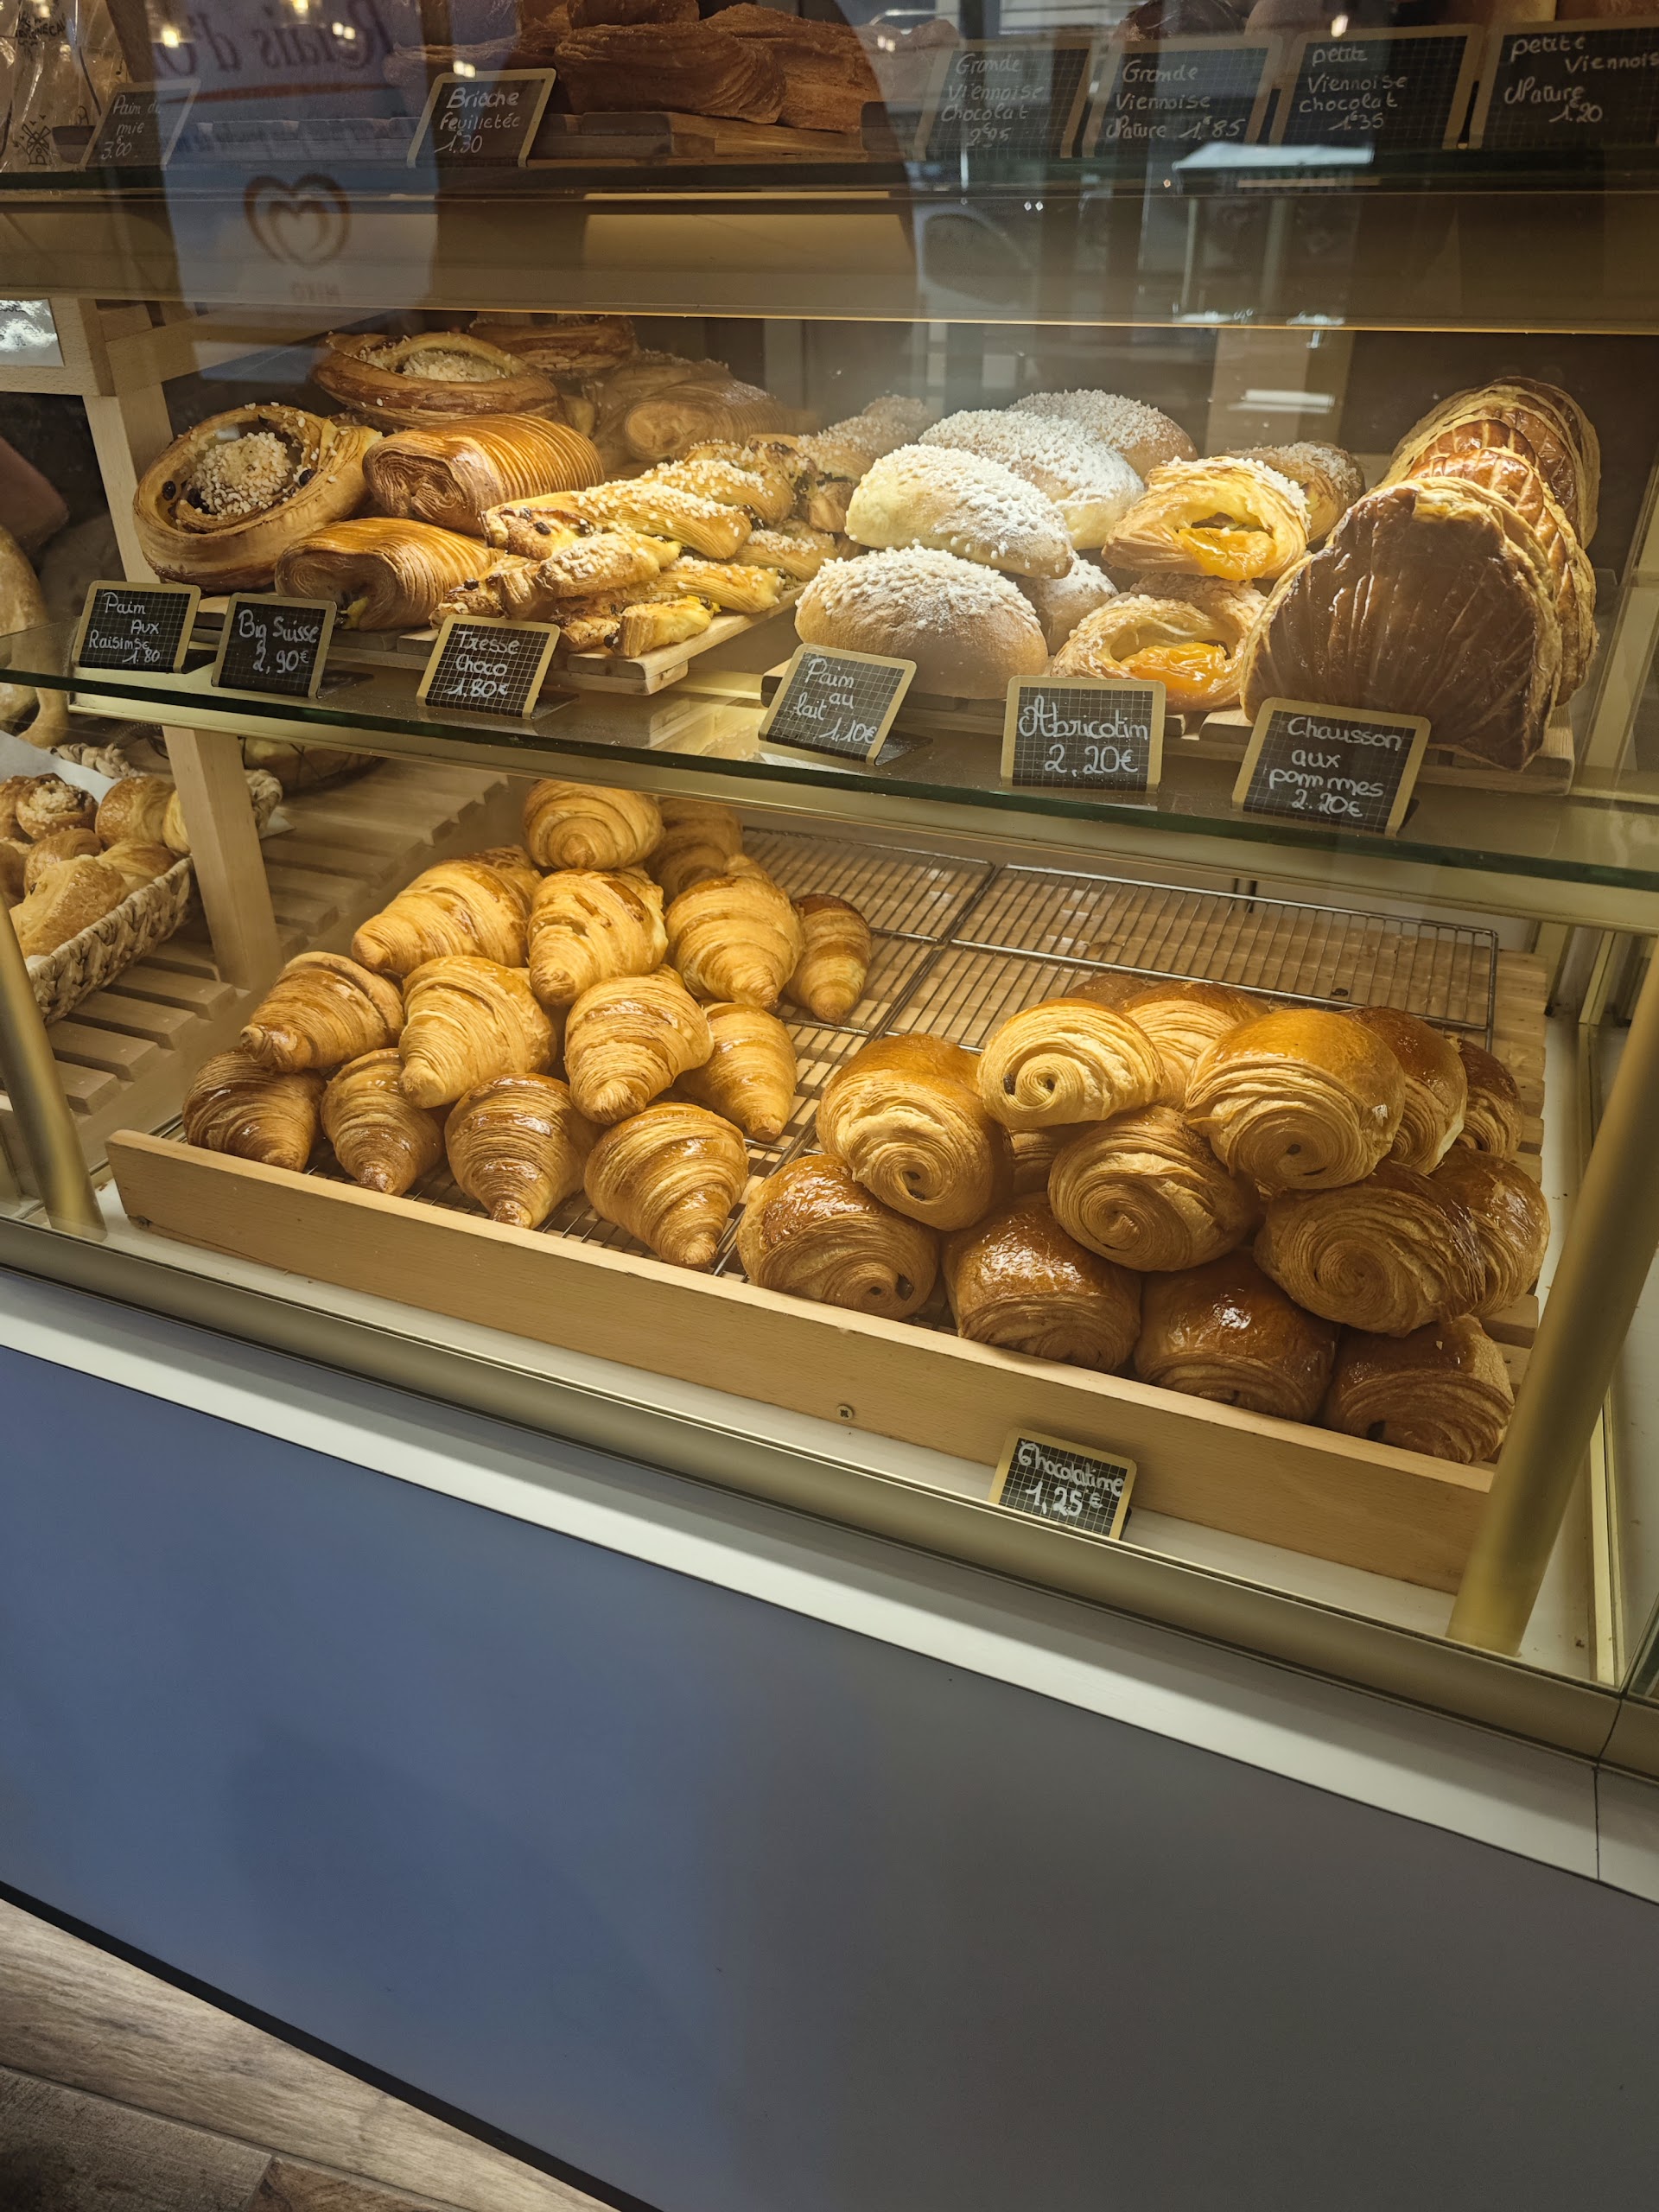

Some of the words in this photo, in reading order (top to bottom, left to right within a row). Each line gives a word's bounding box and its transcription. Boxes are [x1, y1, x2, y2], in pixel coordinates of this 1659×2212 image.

[956, 53, 1022, 74] Grande
[1122, 59, 1199, 83] Grande
[1307, 73, 1408, 93] Viennoise
[446, 86, 519, 109] Brioche
[1116, 92, 1211, 111] Viennoise
[829, 693, 854, 709] au
[1287, 716, 1402, 752] Chausson
[1291, 749, 1340, 768] aux
